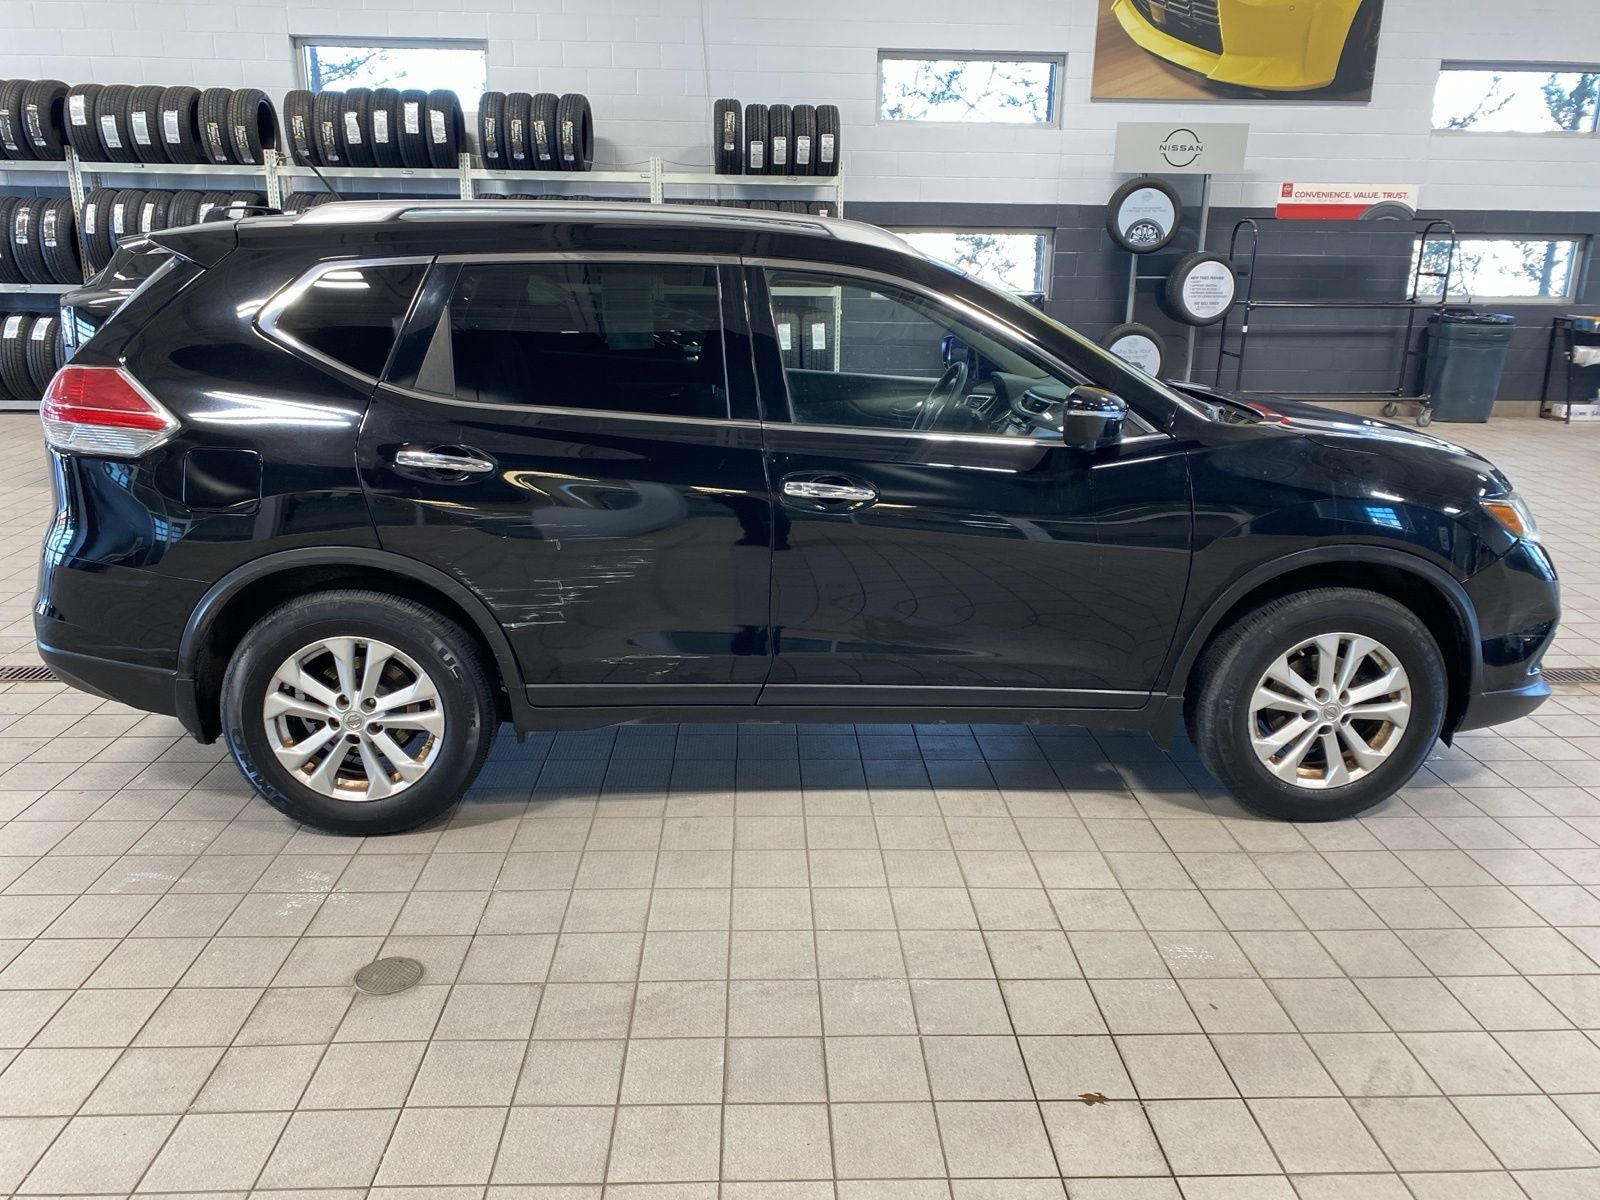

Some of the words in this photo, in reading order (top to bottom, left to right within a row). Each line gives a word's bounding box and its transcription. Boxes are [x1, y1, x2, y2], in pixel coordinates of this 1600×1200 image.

[1159, 144, 1204, 152] NISSAN
[1294, 191, 1351, 199] CONVENIENCE.
[1353, 191, 1380, 199] VALUE.
[1382, 191, 1409, 199] TRUST.
